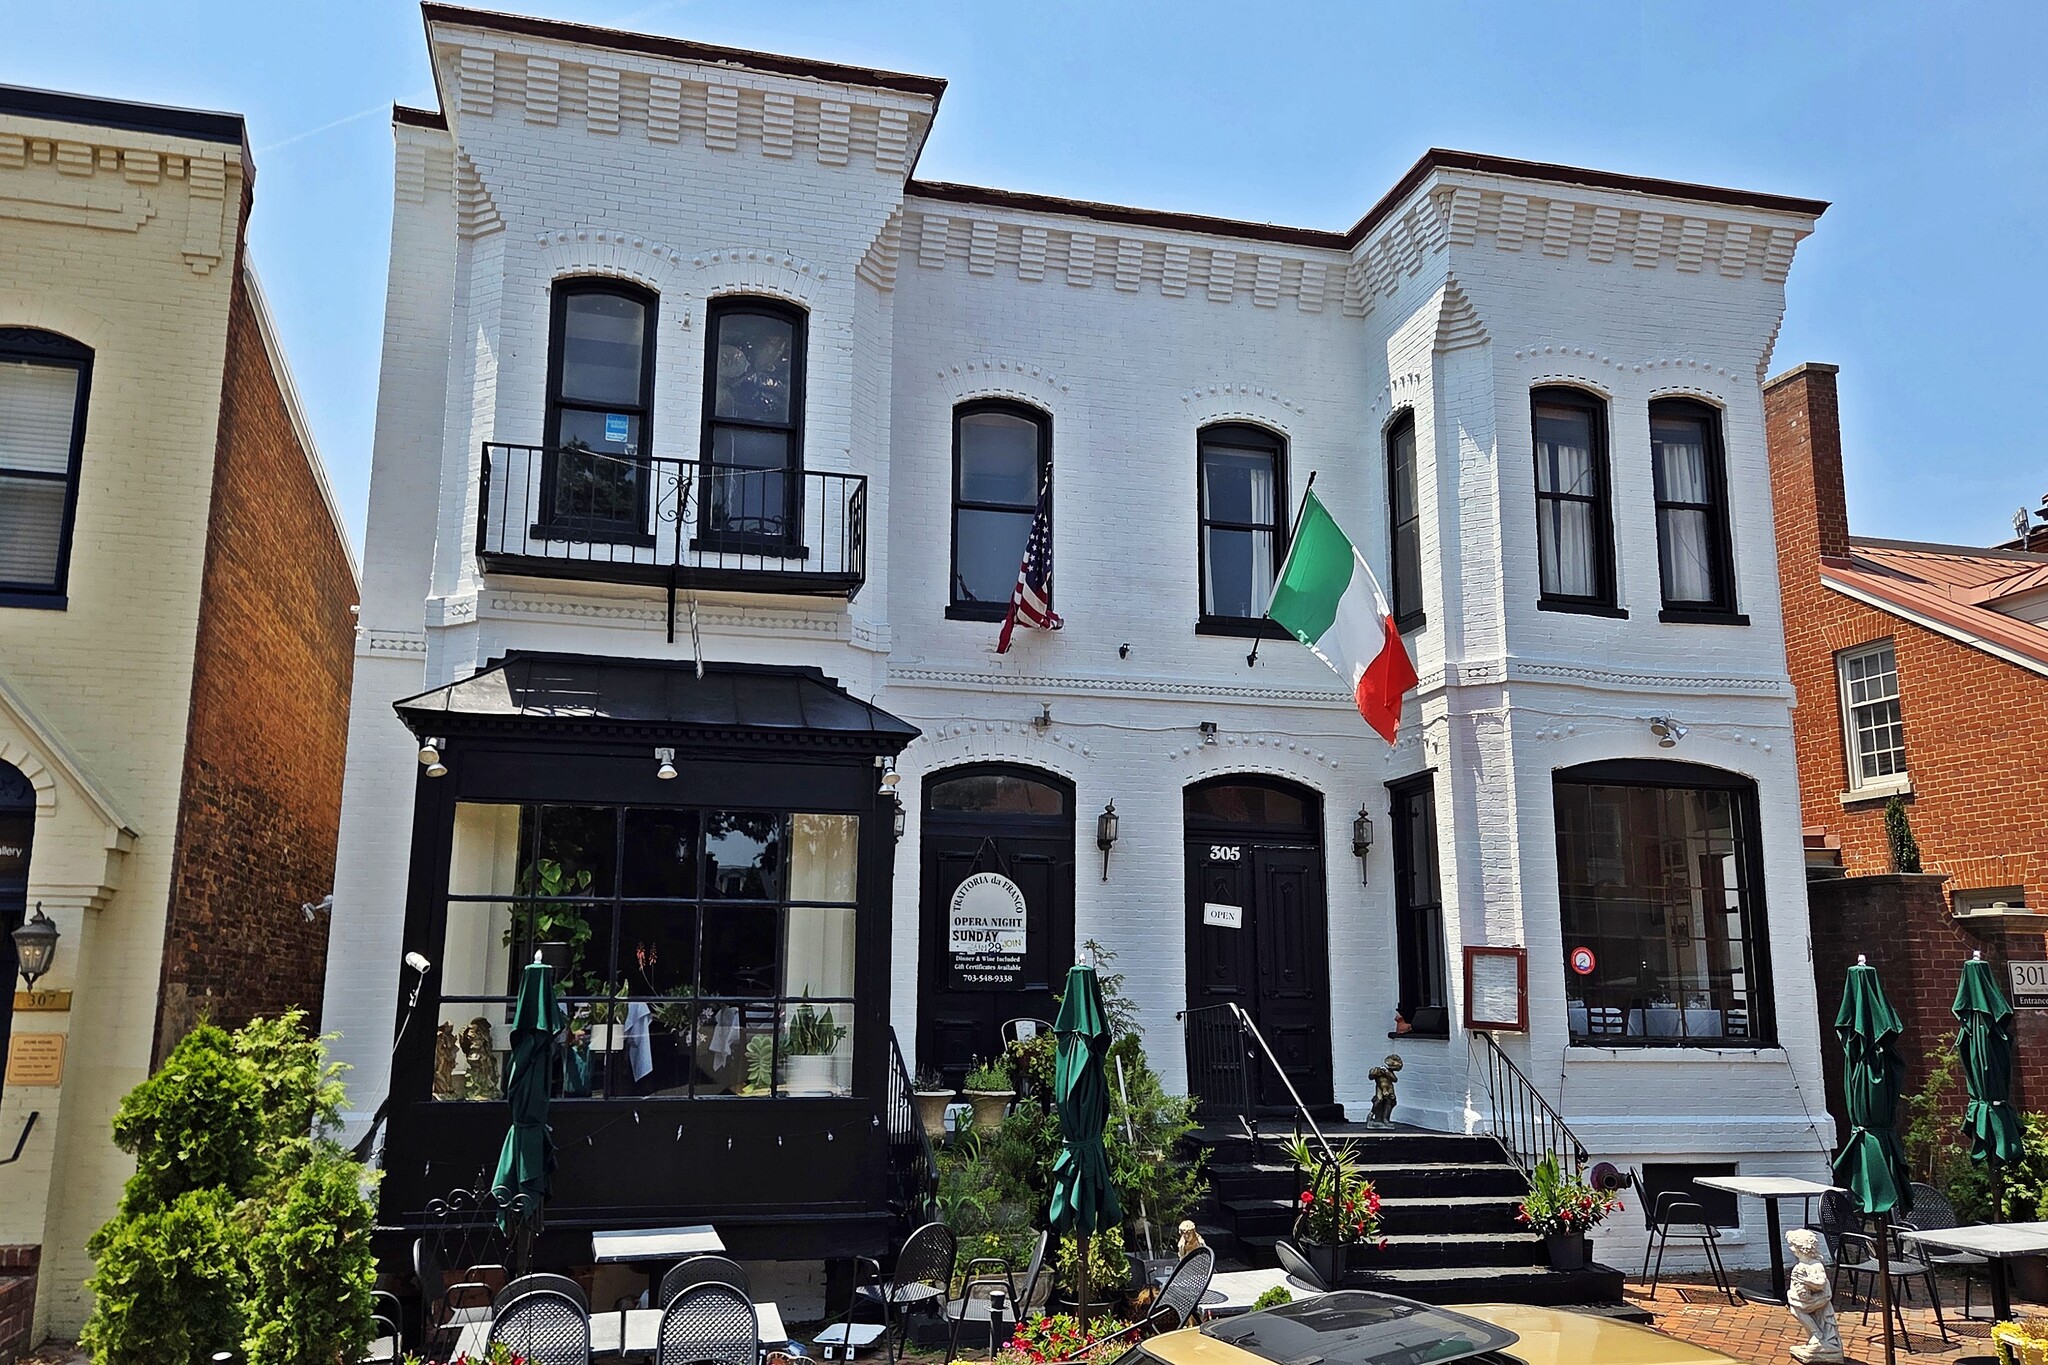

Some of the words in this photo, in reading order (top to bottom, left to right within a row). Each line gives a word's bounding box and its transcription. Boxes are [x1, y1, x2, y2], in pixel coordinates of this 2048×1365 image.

[0, 845, 22, 858] llery
[1210, 844, 1240, 860] 305
[953, 875, 989, 912] TRATTORIA
[990, 875, 1001, 886] da
[1002, 880, 1023, 914] FRANCO
[954, 916, 988, 927] OPERA
[991, 917, 1023, 928] NIGHT
[1210, 910, 1235, 921] OPEN
[952, 930, 999, 943] SUNDAY
[996, 955, 1021, 963] Included
[965, 963, 996, 971] Certificates
[997, 963, 1022, 971] Available
[962, 974, 1013, 983] 703-548-9338
[2014, 965, 2048, 986] 301
[28, 993, 57, 1007] 307
